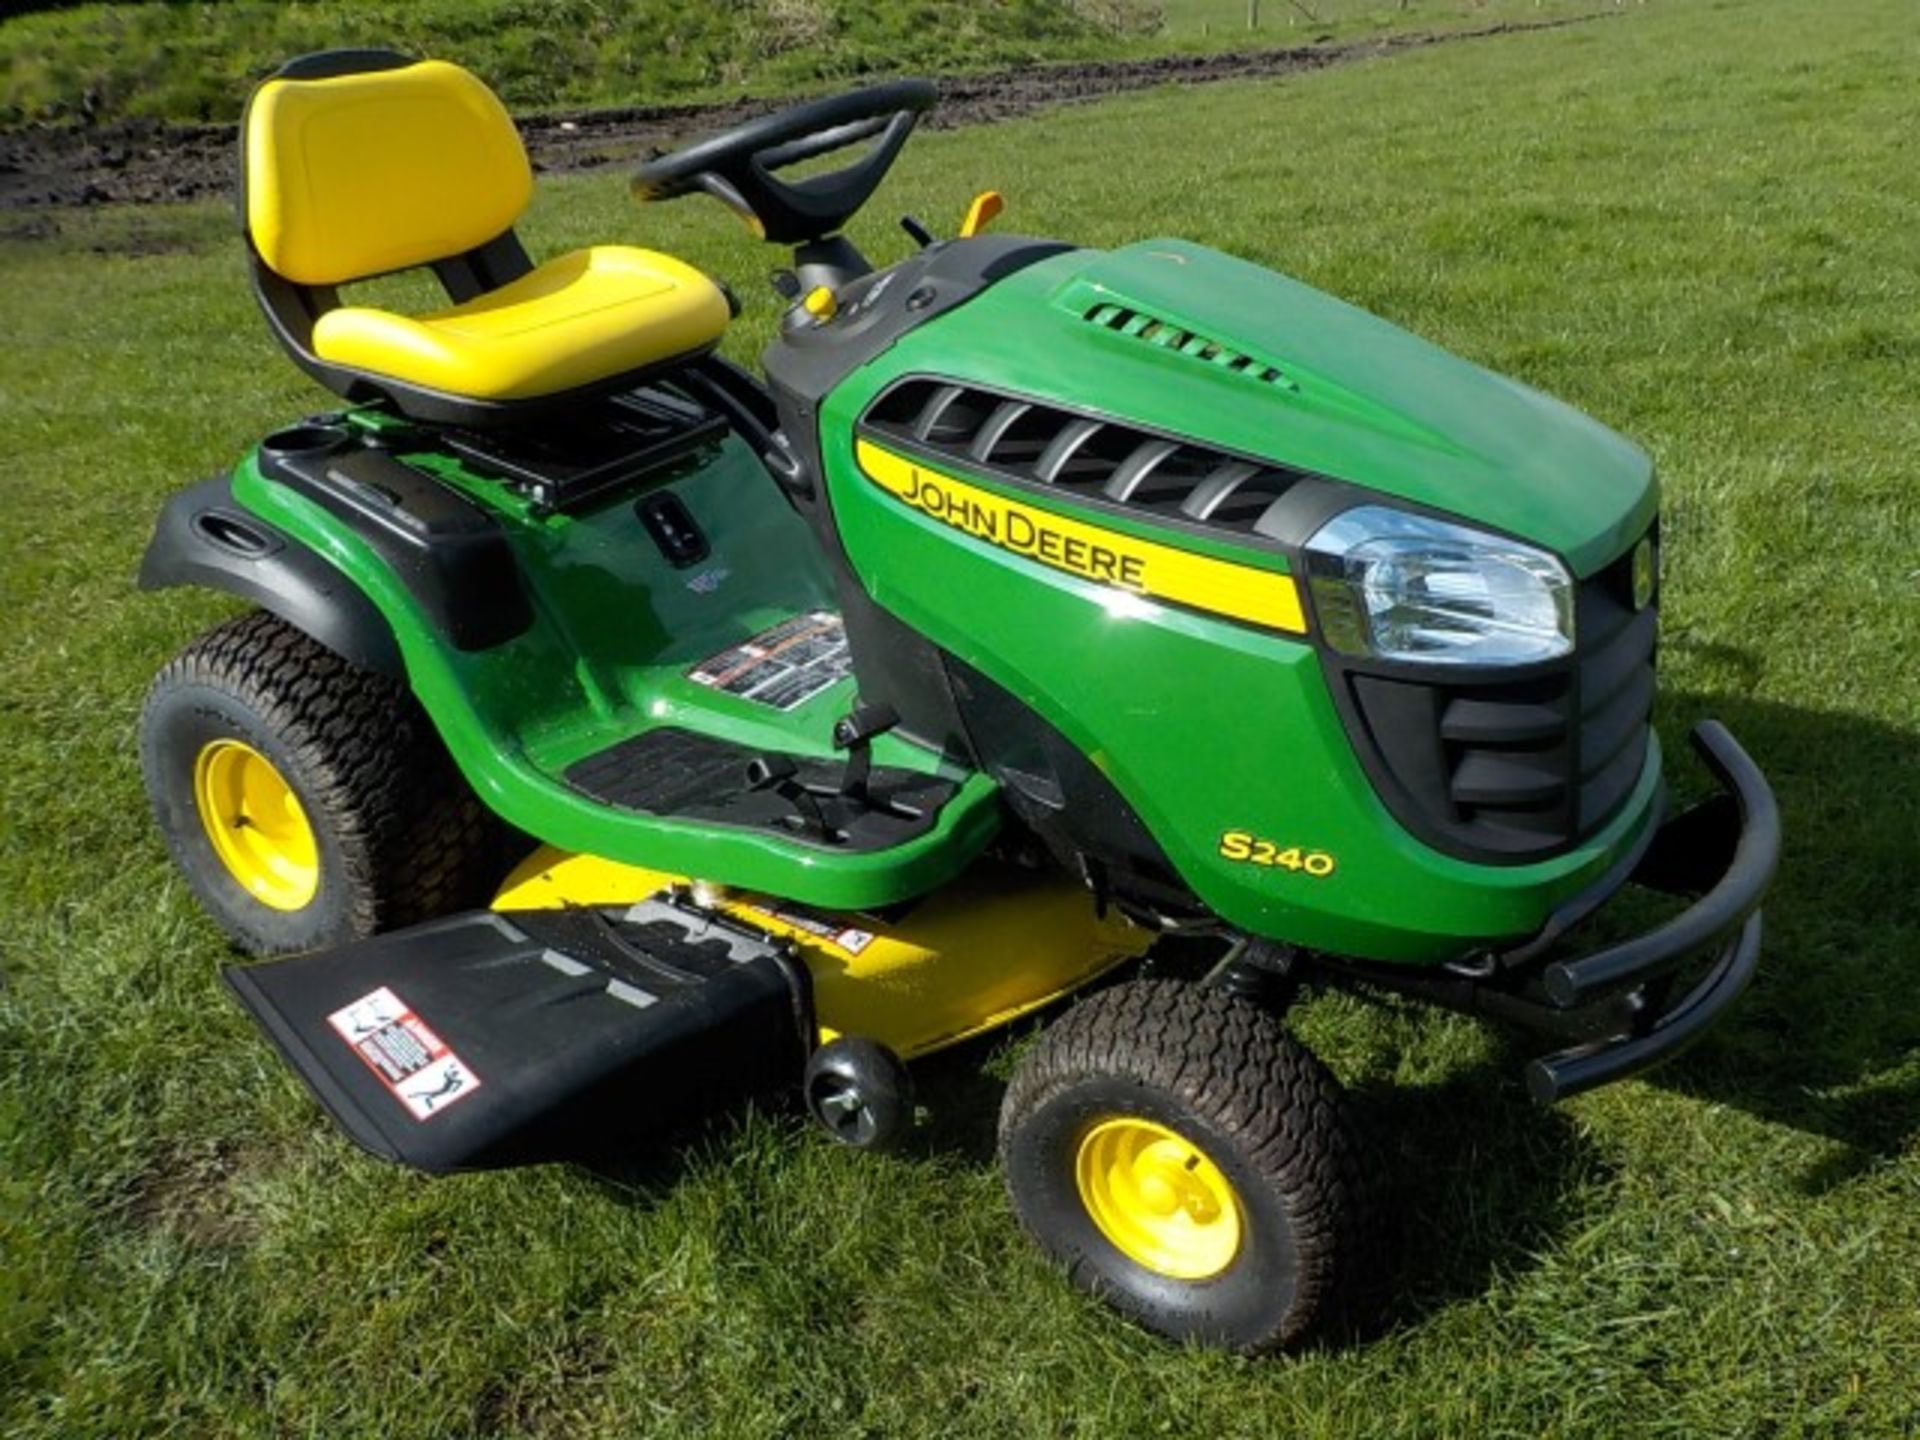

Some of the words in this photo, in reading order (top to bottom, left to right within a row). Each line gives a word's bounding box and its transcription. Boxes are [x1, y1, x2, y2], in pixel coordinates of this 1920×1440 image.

[901, 470, 996, 537] JOHN
[1005, 510, 1146, 588] DEERE
[1219, 831, 1334, 876] S240
